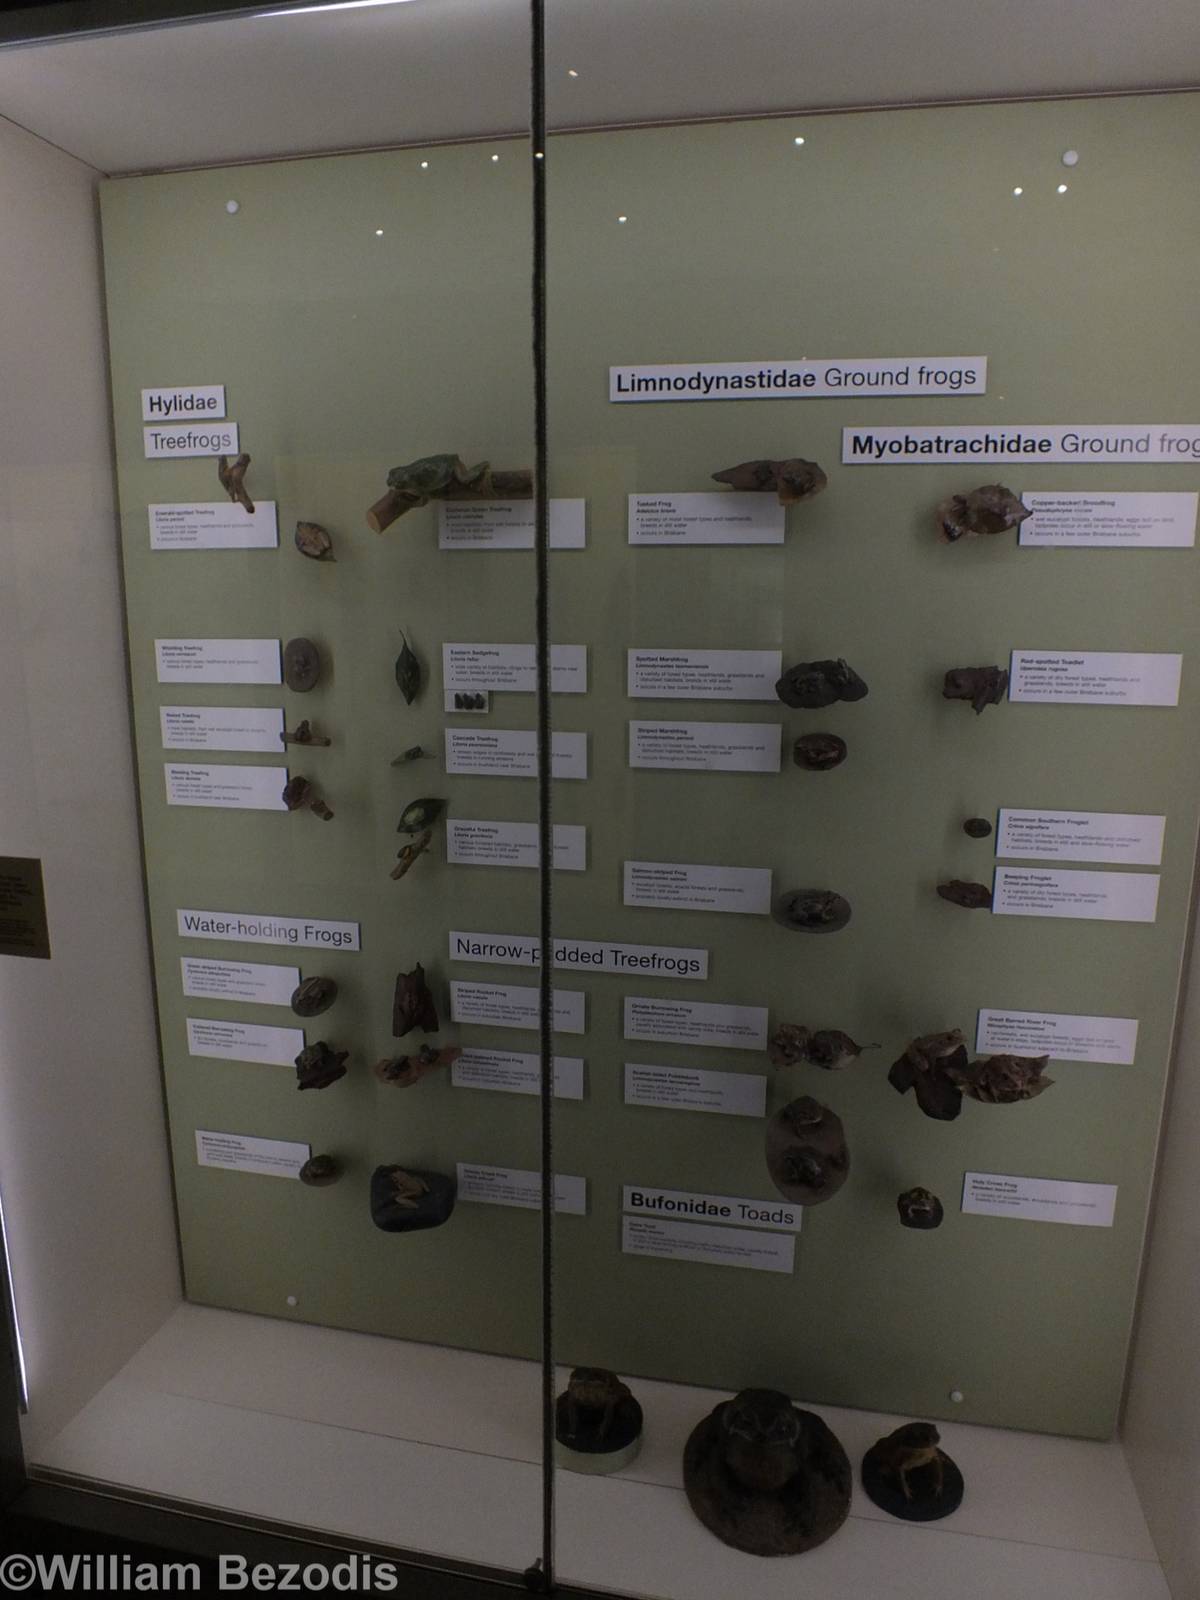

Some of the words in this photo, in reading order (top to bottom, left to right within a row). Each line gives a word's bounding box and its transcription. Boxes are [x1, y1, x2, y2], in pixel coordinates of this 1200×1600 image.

[617, 369, 816, 393] Limnodynastidae
[825, 367, 909, 387] Ground
[918, 365, 976, 389] frogs
[149, 394, 217, 416] Hylidae
[150, 430, 231, 452] Treefrogs
[852, 433, 1051, 457] Myobatrachidae
[1061, 433, 1150, 453] Ground
[184, 916, 299, 943] Water-holding
[304, 925, 352, 946] Frogs
[457, 938, 603, 965] Narrow-pdded
[610, 949, 701, 975] Treefrogs
[630, 1192, 731, 1217] Bufonidae
[737, 1204, 795, 1225] Toads
